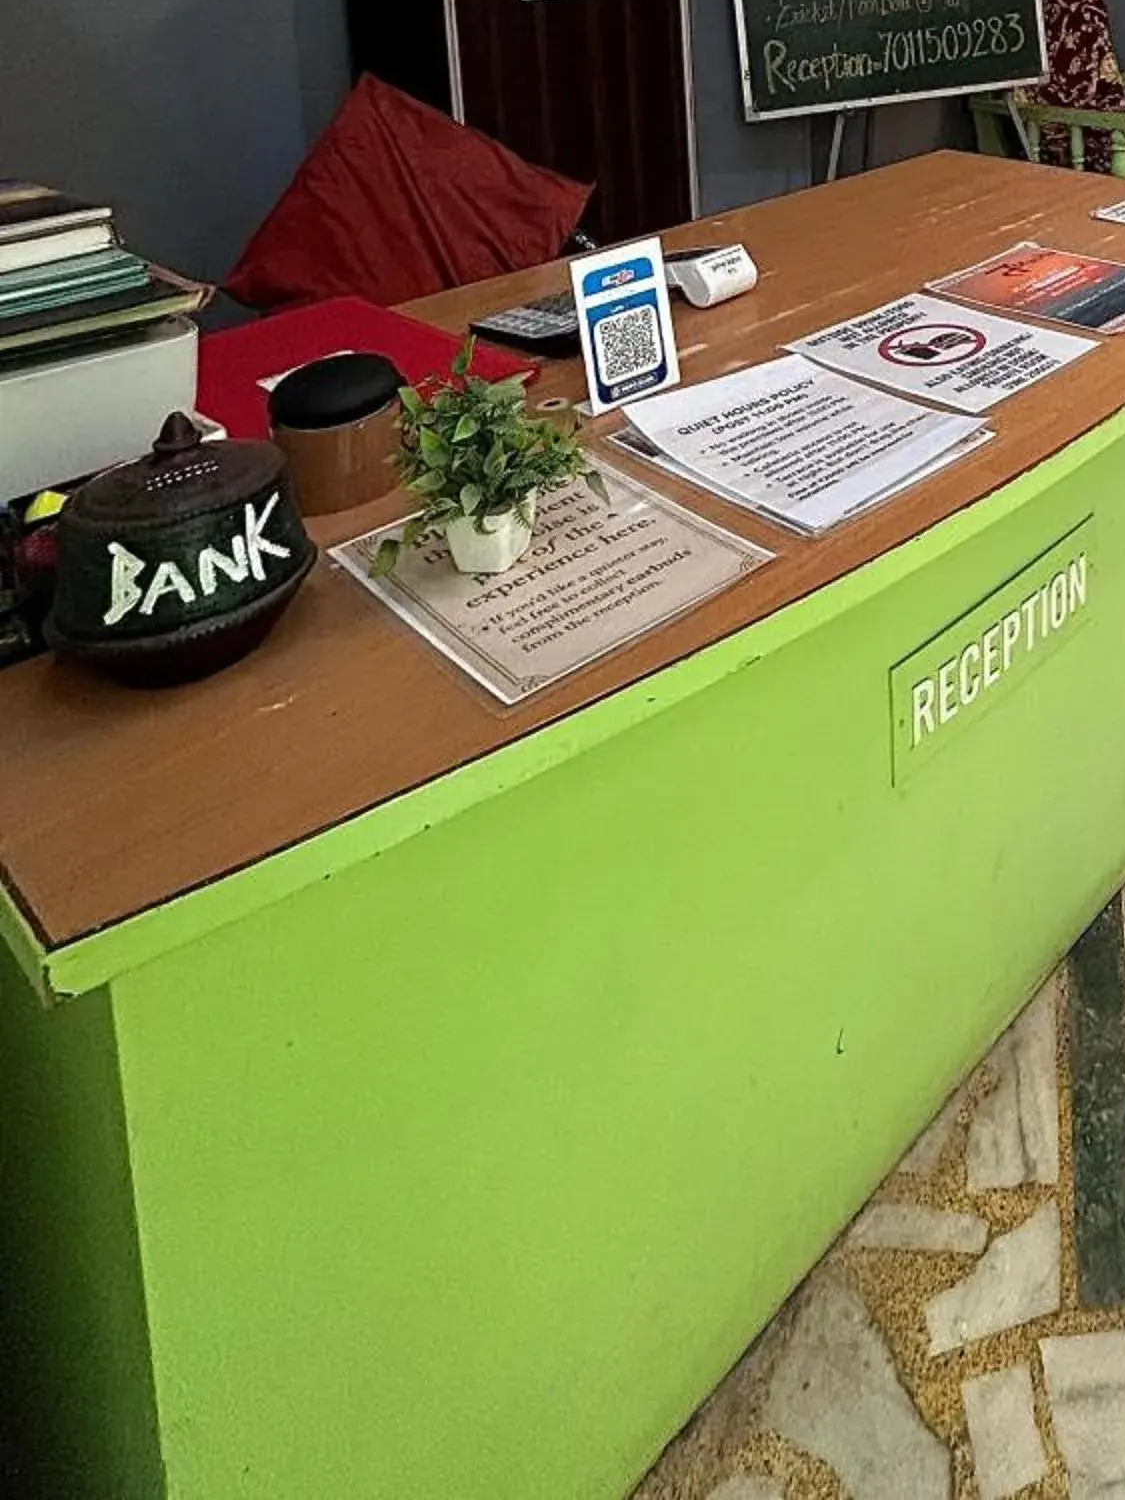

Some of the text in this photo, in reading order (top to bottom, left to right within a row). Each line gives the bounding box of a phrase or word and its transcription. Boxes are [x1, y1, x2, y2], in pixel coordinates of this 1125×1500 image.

[677, 379, 813, 434] QUIET HOURS POLICY
[103, 491, 292, 626] BANK
[466, 519, 655, 607] experience here.
[531, 538, 555, 556] of
[564, 521, 602, 540] the
[910, 550, 1087, 750] RECEPTION
